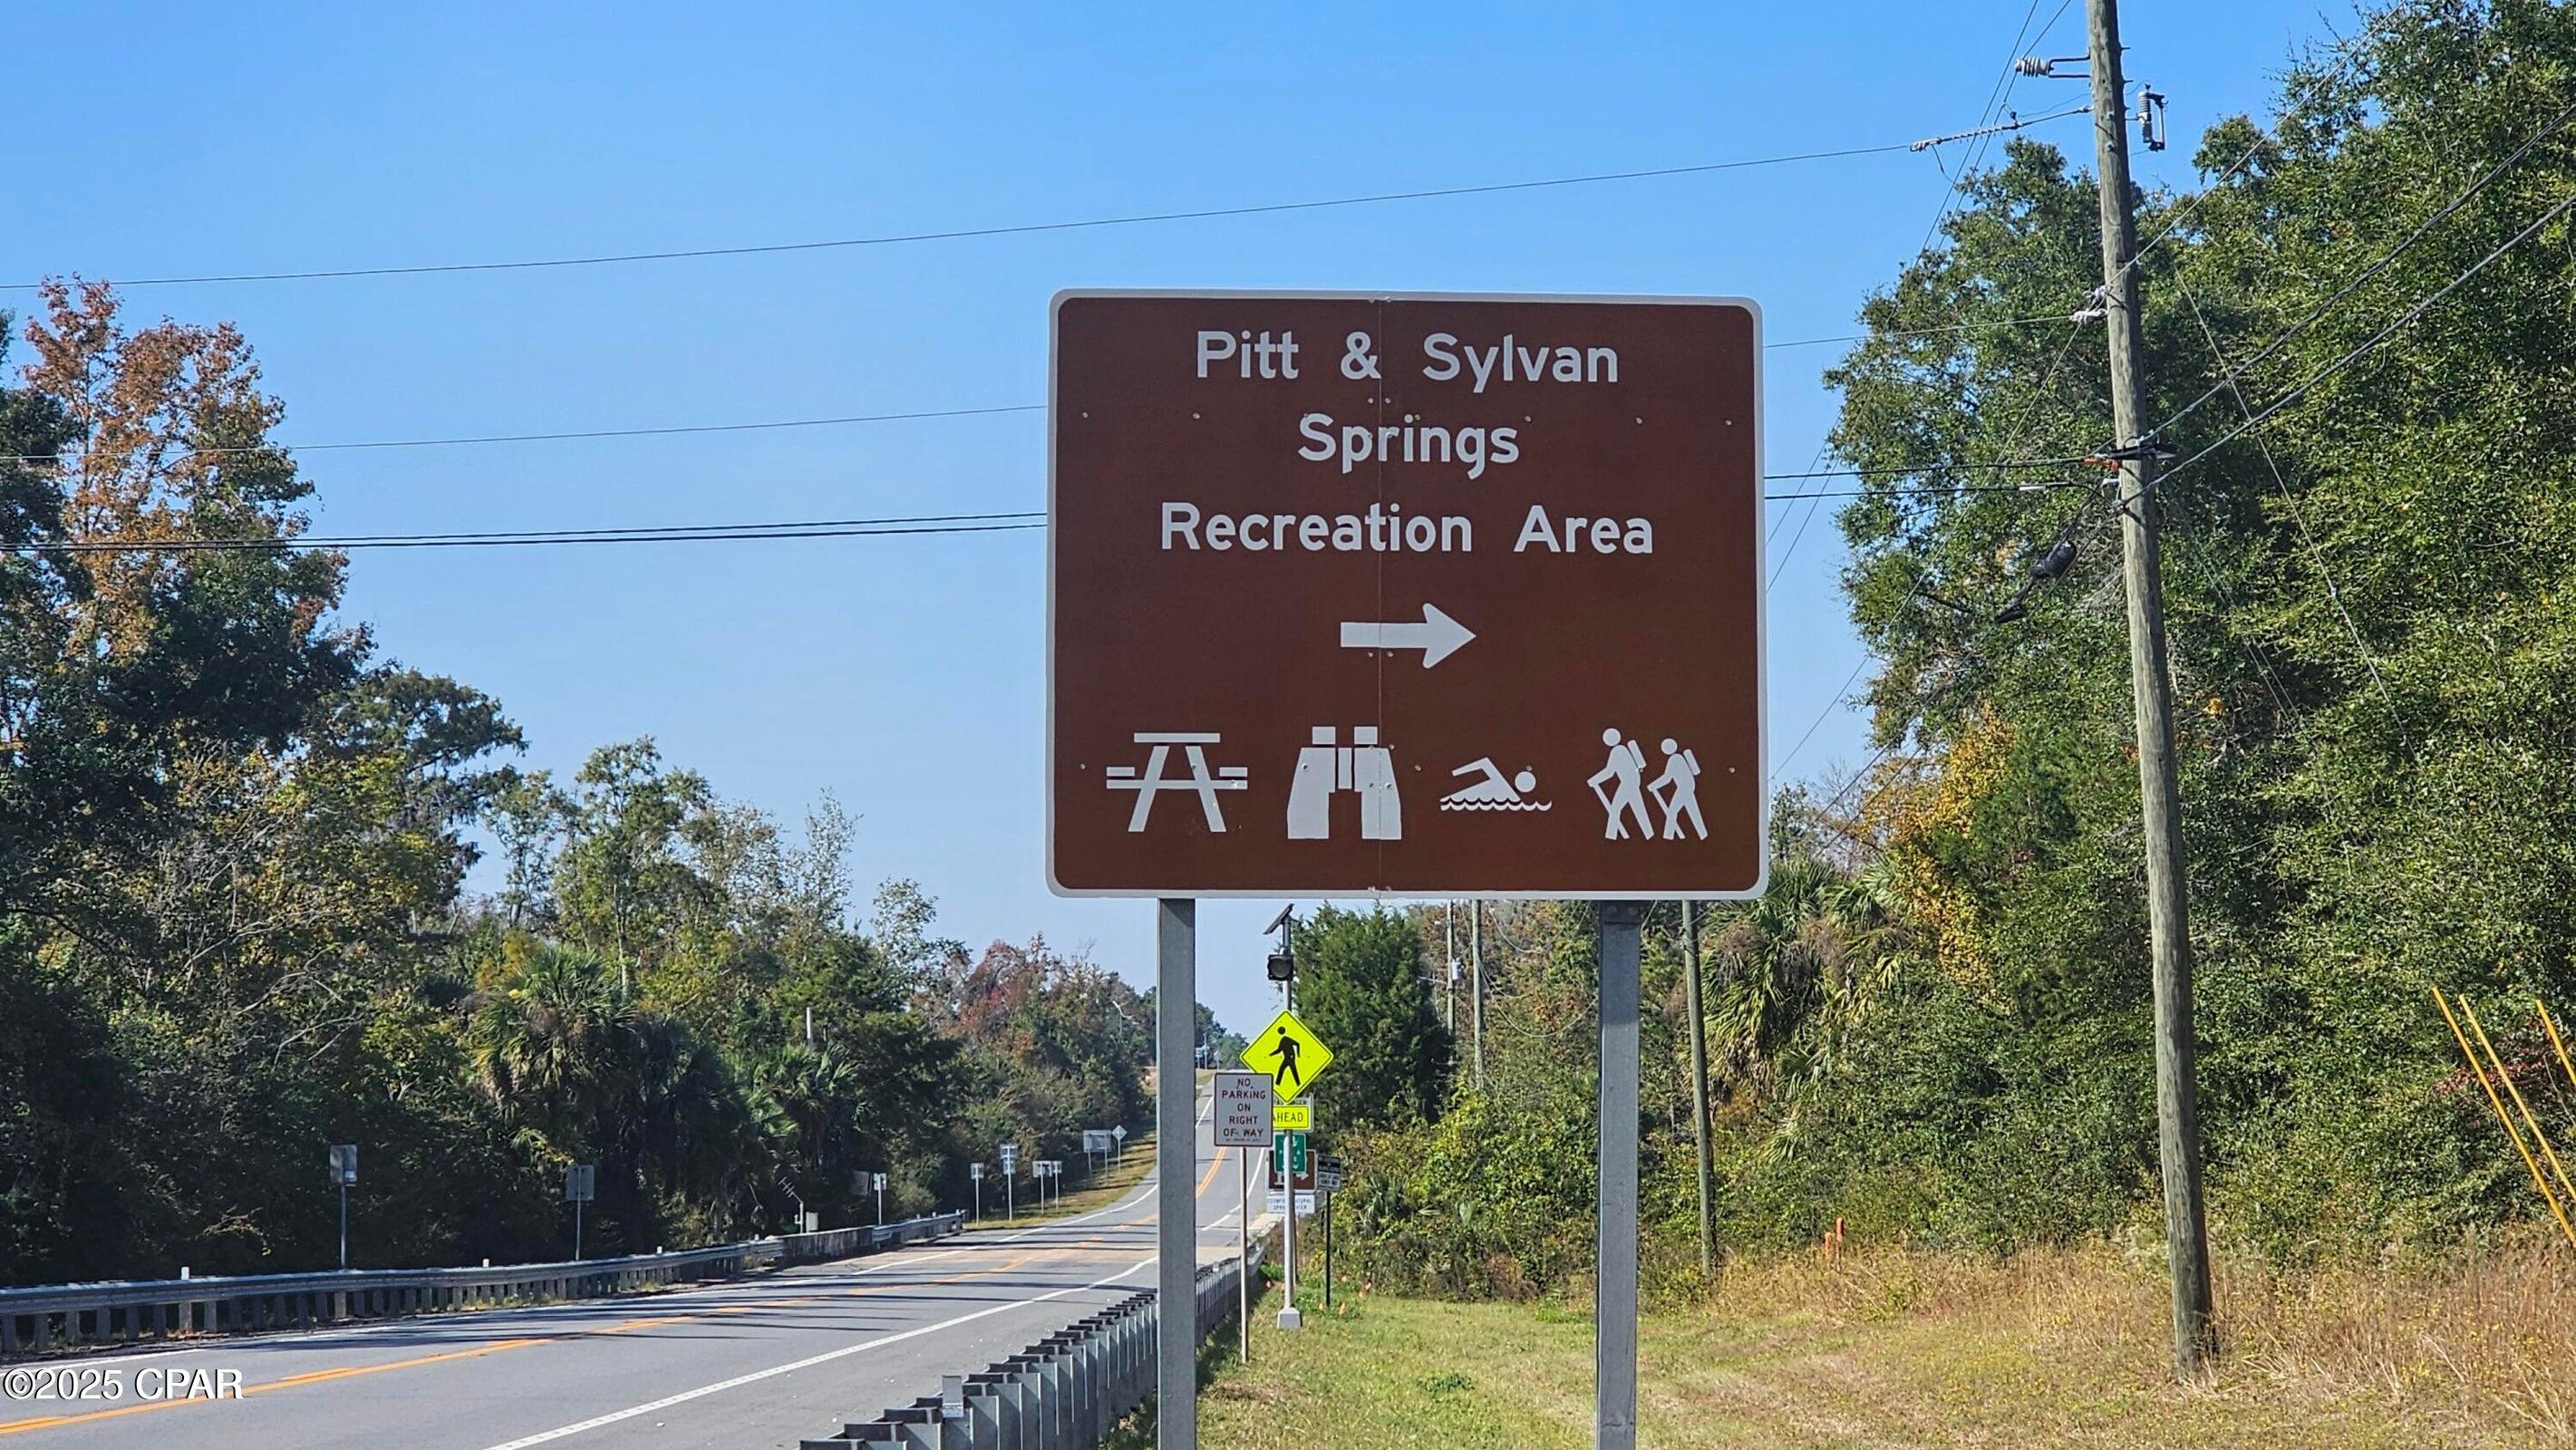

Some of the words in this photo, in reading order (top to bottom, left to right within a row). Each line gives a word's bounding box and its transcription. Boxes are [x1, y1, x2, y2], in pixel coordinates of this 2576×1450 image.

[1197, 331, 1299, 379] Pitt
[1341, 332, 1381, 380] &
[1422, 333, 1618, 393] Sylvan
[1297, 413, 1519, 480] Springs
[1162, 502, 1472, 552] Recreation
[1513, 505, 1653, 554] Area
[1237, 1078, 1251, 1087] NO
[1222, 1090, 1266, 1099] PARKING
[1237, 1103, 1251, 1112] ON
[1229, 1116, 1258, 1125] RIGHT
[1224, 1128, 1236, 1136] OF
[1243, 1128, 1264, 1137] WAY
